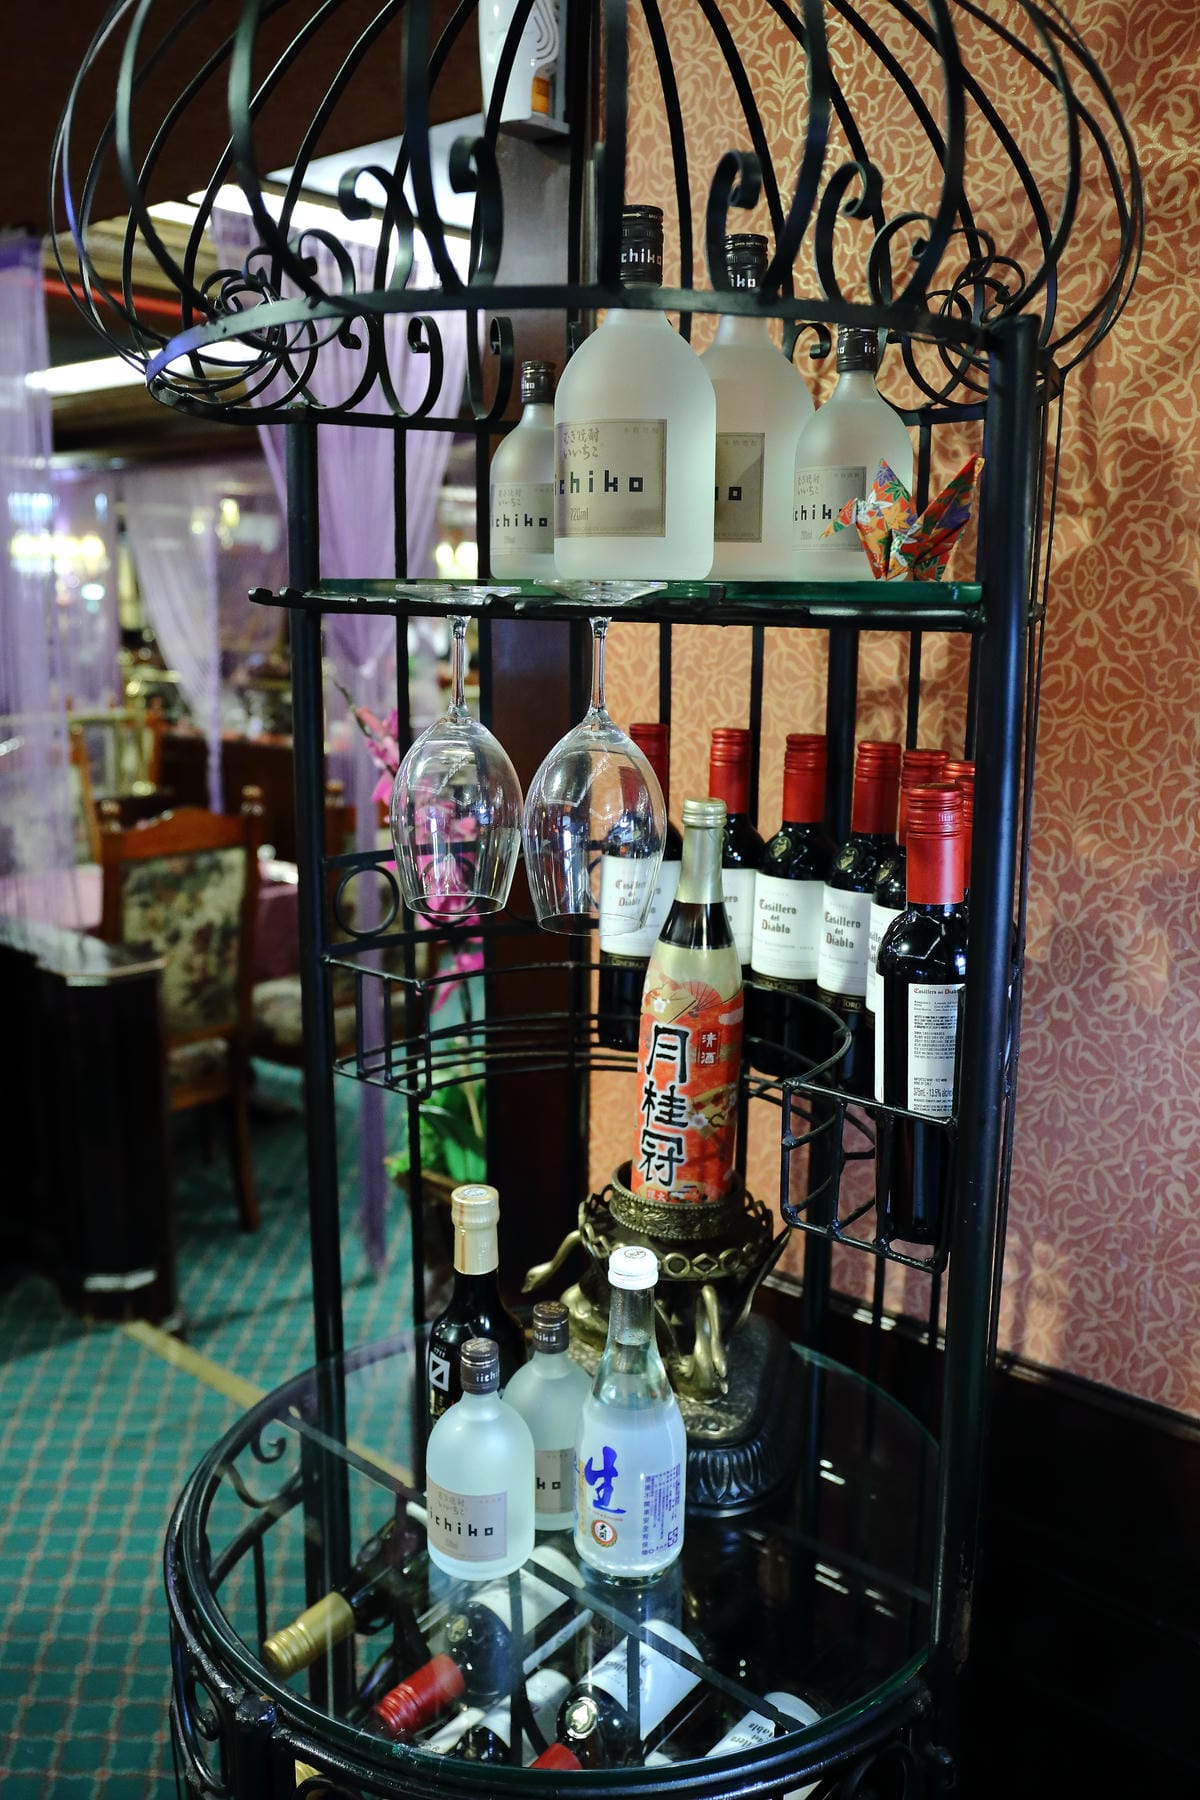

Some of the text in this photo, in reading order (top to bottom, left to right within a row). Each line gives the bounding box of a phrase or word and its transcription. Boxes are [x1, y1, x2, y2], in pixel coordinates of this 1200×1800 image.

[620, 248, 662, 265] chiko
[759, 899, 798, 915] Casillero
[761, 919, 791, 934] Diablo
[824, 911, 861, 929] Casillero
[825, 932, 854, 949] Diablo
[701, 1032, 717, 1065] 清酒
[584, 1446, 627, 1514] 生
